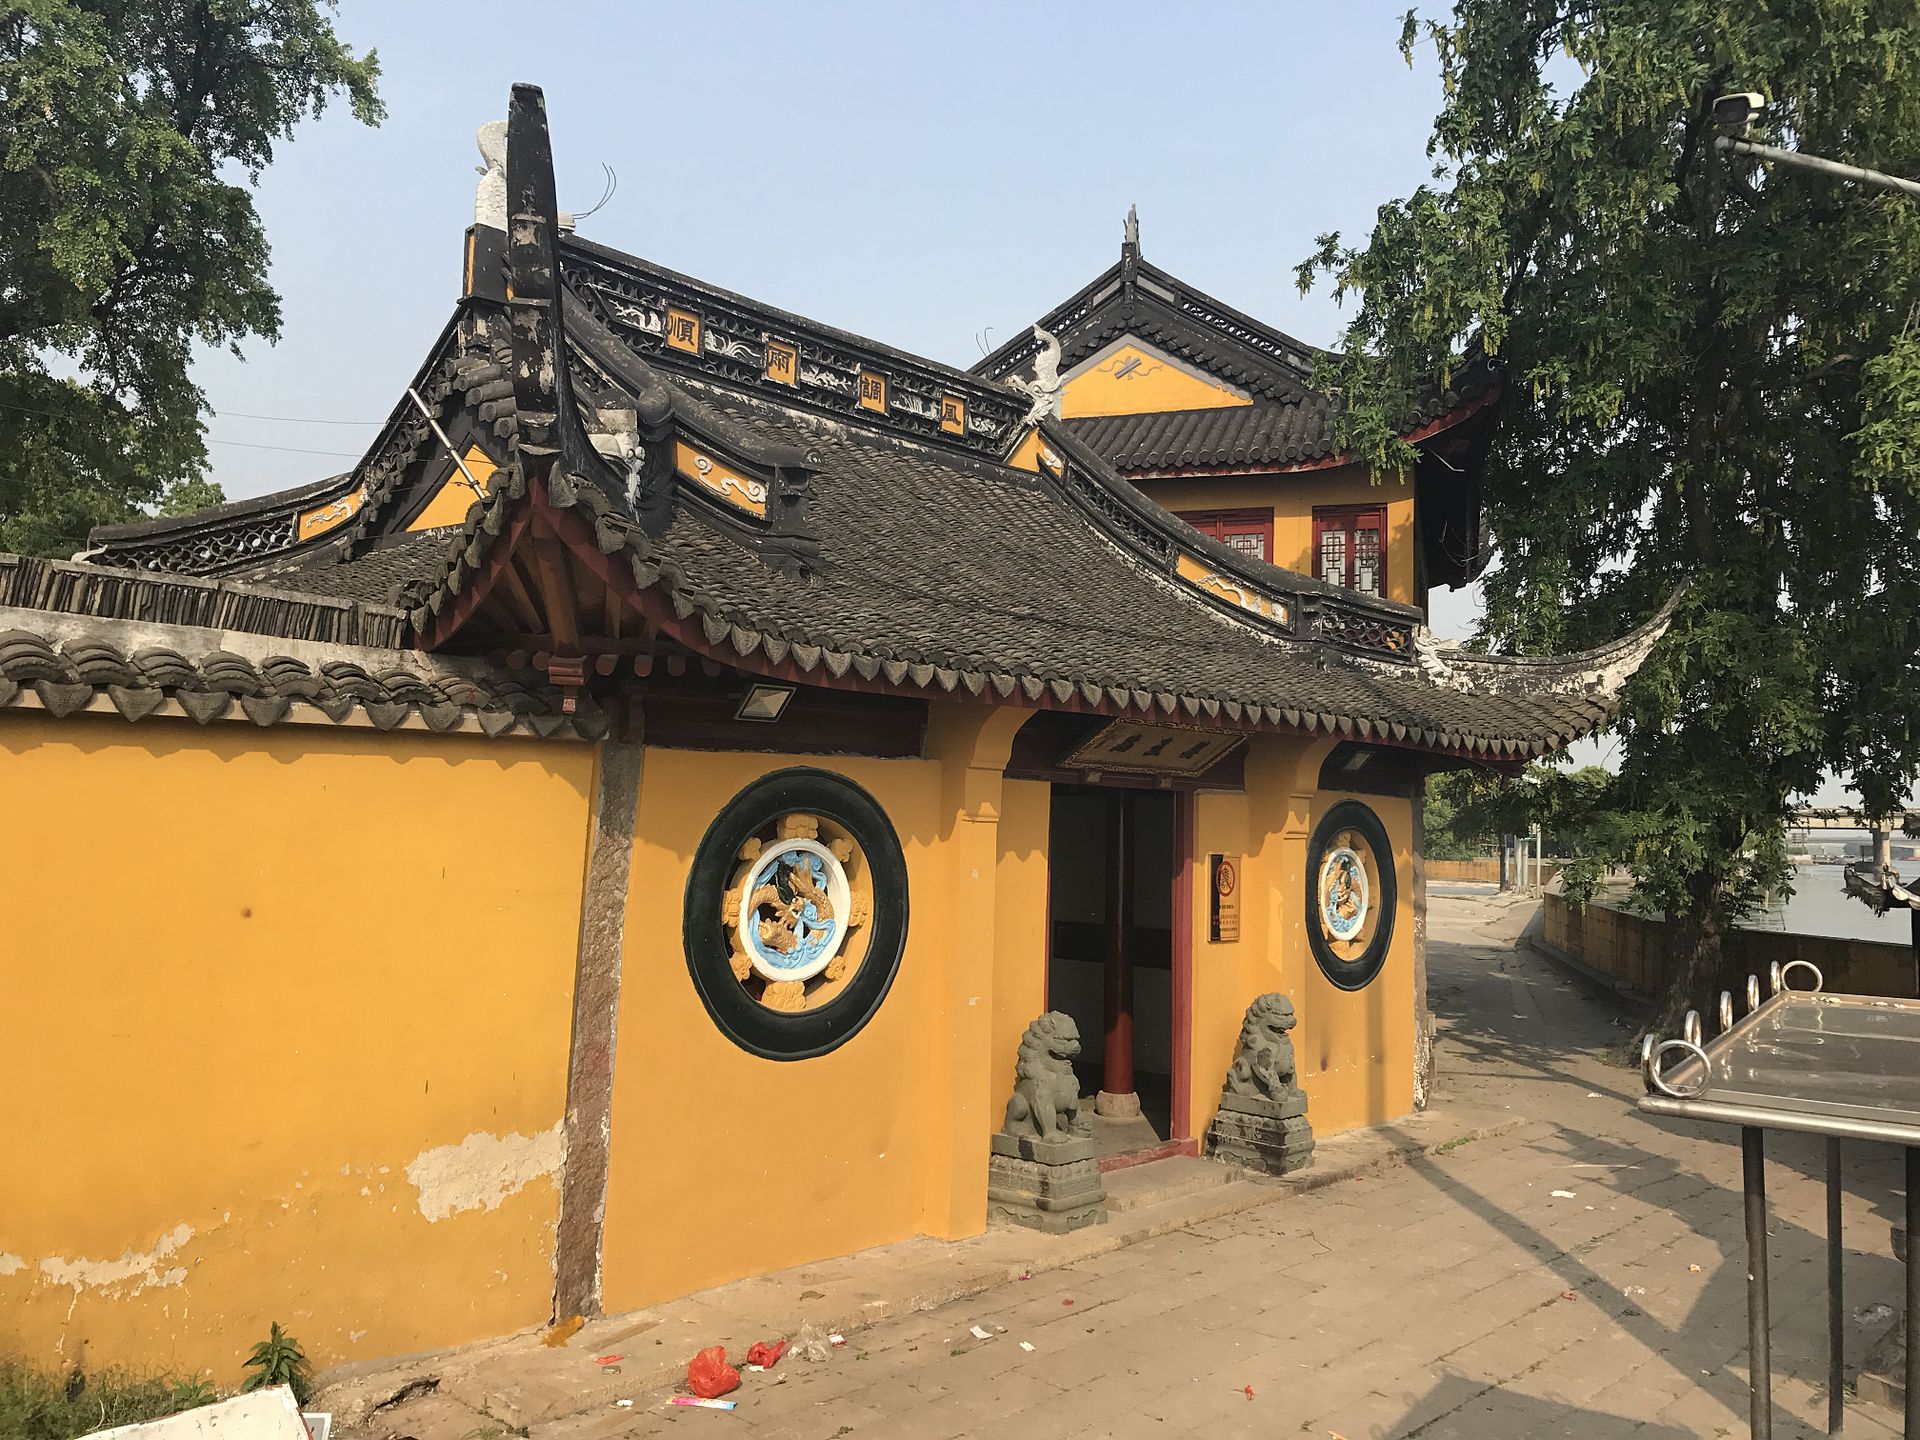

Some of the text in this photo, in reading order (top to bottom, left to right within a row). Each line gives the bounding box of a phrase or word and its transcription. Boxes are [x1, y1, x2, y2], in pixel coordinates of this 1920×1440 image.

[667, 315, 695, 346] 順
[768, 345, 794, 374] 雨
[861, 377, 882, 404] 調
